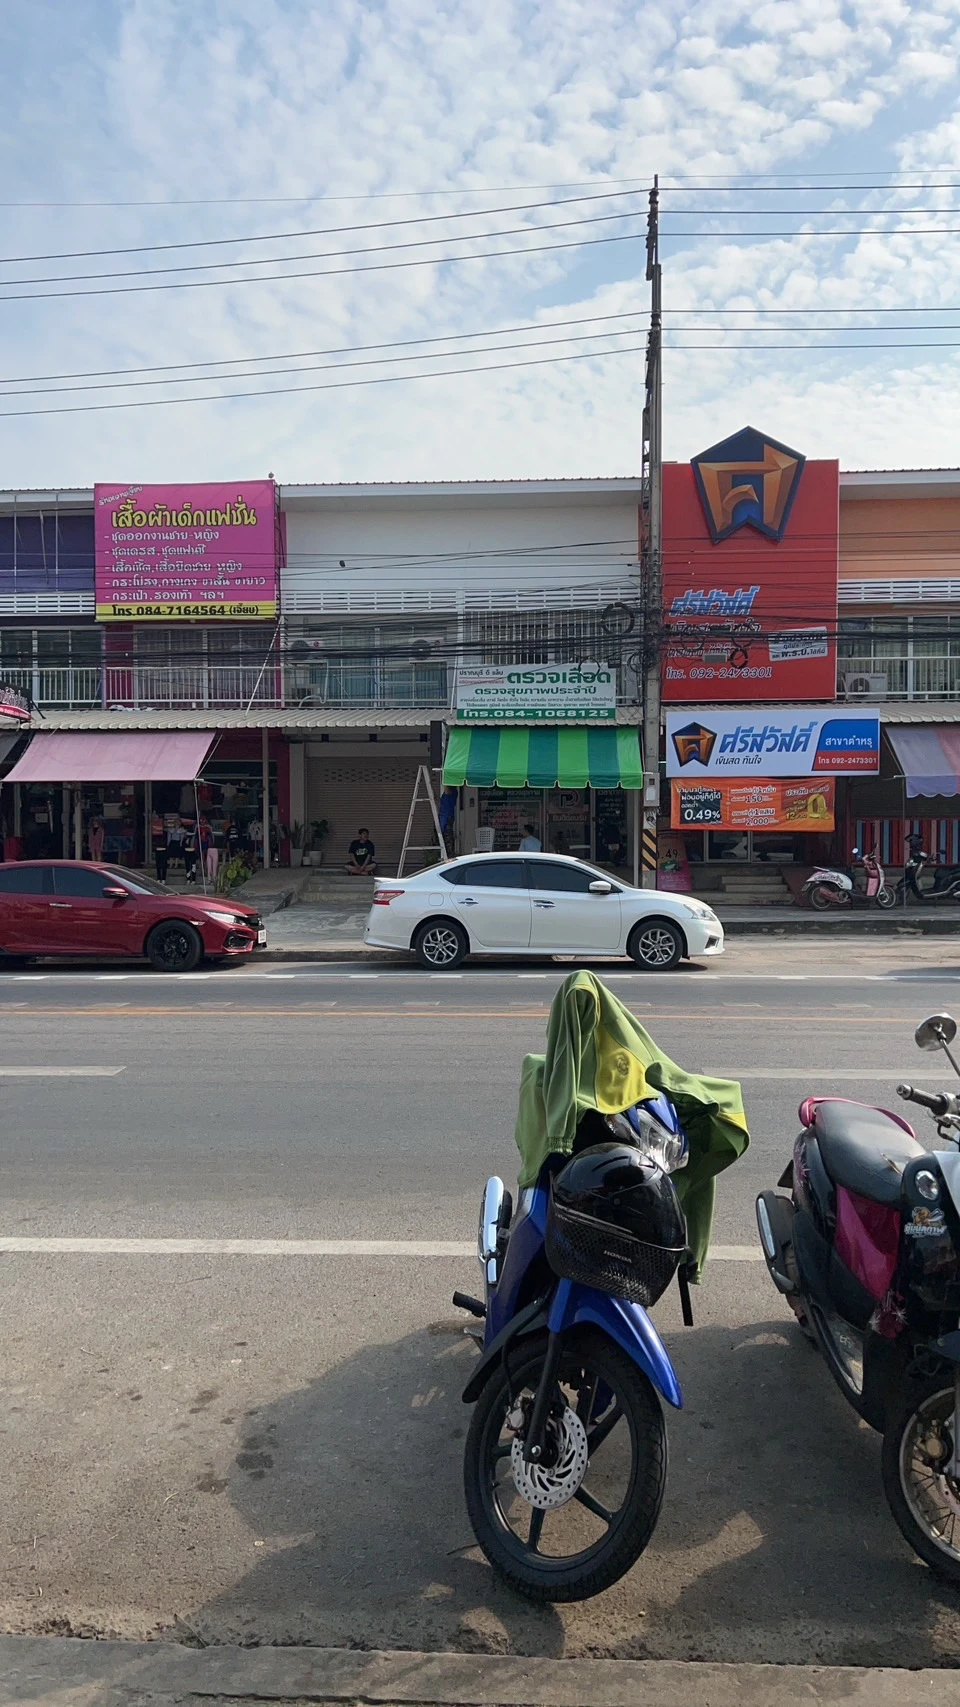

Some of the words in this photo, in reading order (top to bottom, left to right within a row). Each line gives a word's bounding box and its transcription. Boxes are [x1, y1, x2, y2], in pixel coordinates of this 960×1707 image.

[111, 495, 257, 528] เสื้อผ้าเด็กแฟชั่น
[507, 667, 611, 684] ตรวจเลือด
[474, 685, 597, 697] ตรวจสุขภาพประจำปี
[463, 709, 609, 718] โทร.084-1068125
[825, 735, 873, 748] สาขาตำหรุ
[715, 755, 741, 765] เงินสด
[742, 754, 762, 765] ทันใจ
[684, 809, 720, 820] 0.49%
[603, 1249, 632, 1263] HONDA
